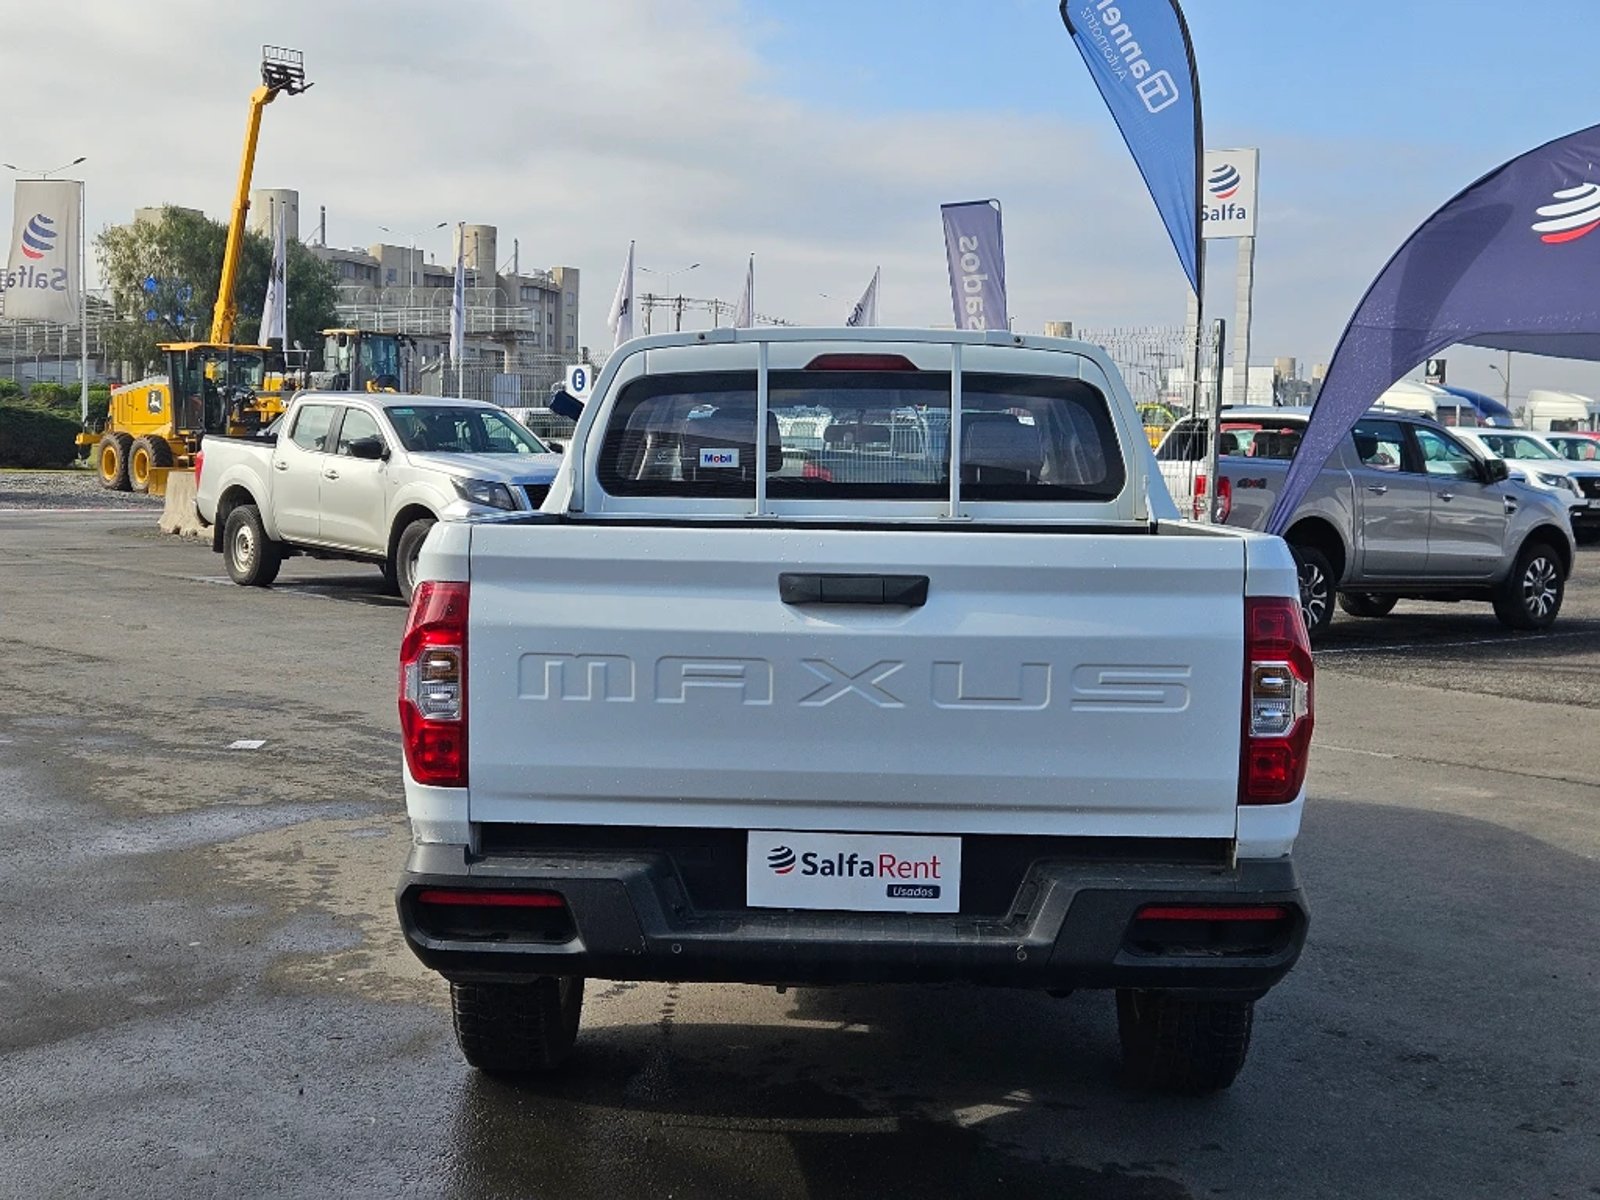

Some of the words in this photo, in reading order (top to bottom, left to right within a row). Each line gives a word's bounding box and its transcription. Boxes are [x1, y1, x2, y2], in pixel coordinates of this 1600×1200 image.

[1201, 203, 1246, 221] Salfa
[575, 372, 583, 388] E
[704, 453, 732, 463] Mobil
[517, 651, 1192, 713] MAXUS
[893, 886, 934, 898] Usados
